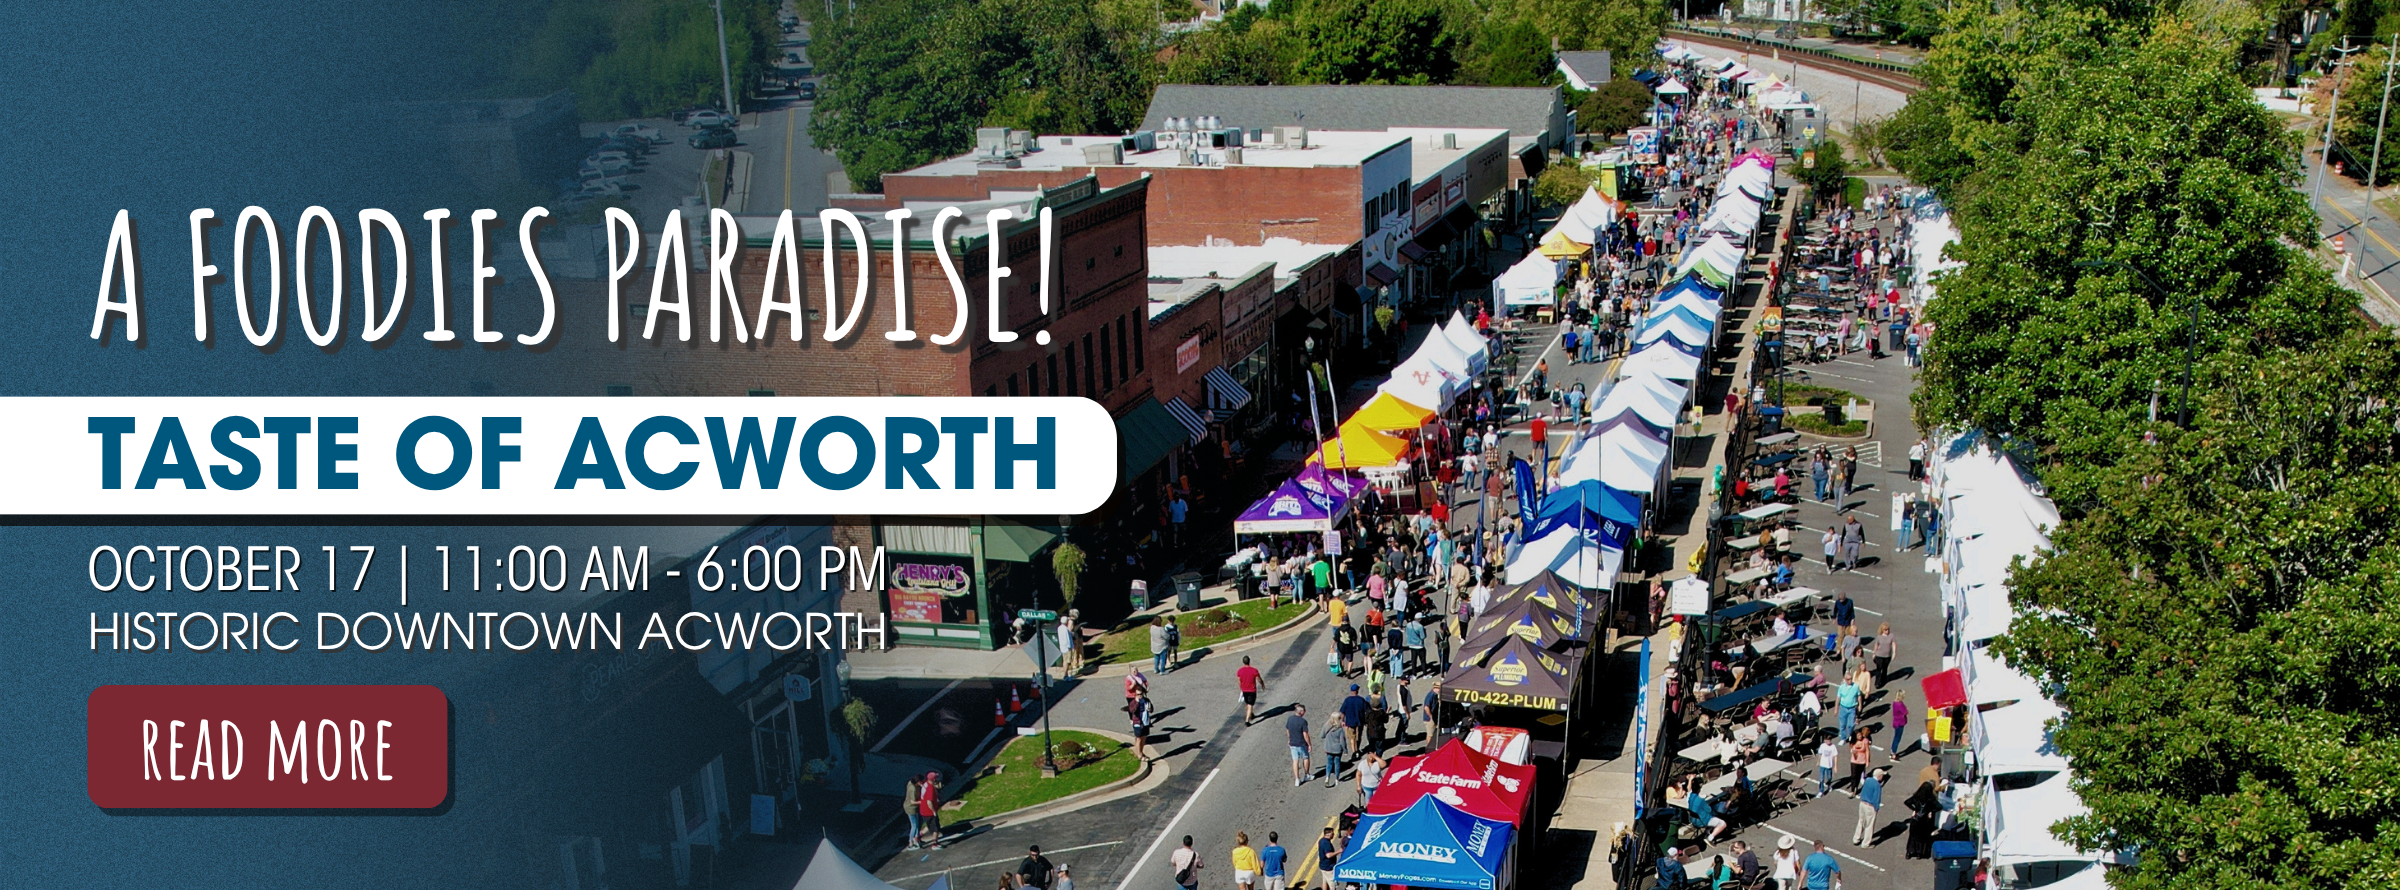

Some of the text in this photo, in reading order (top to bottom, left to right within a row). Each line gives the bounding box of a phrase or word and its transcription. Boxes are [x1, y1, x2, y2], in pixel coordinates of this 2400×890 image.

[896, 563, 964, 584] HENRY'S
[1021, 611, 1046, 619] DALLAS
[1493, 665, 1525, 673] Superior
[1454, 689, 1557, 710] 770-422-PLUM
[1466, 819, 1488, 853] MONEY
[1379, 841, 1459, 860] MONEY
[1340, 868, 1377, 878] MONEY
[1378, 873, 1437, 883] MoneyPages.com
